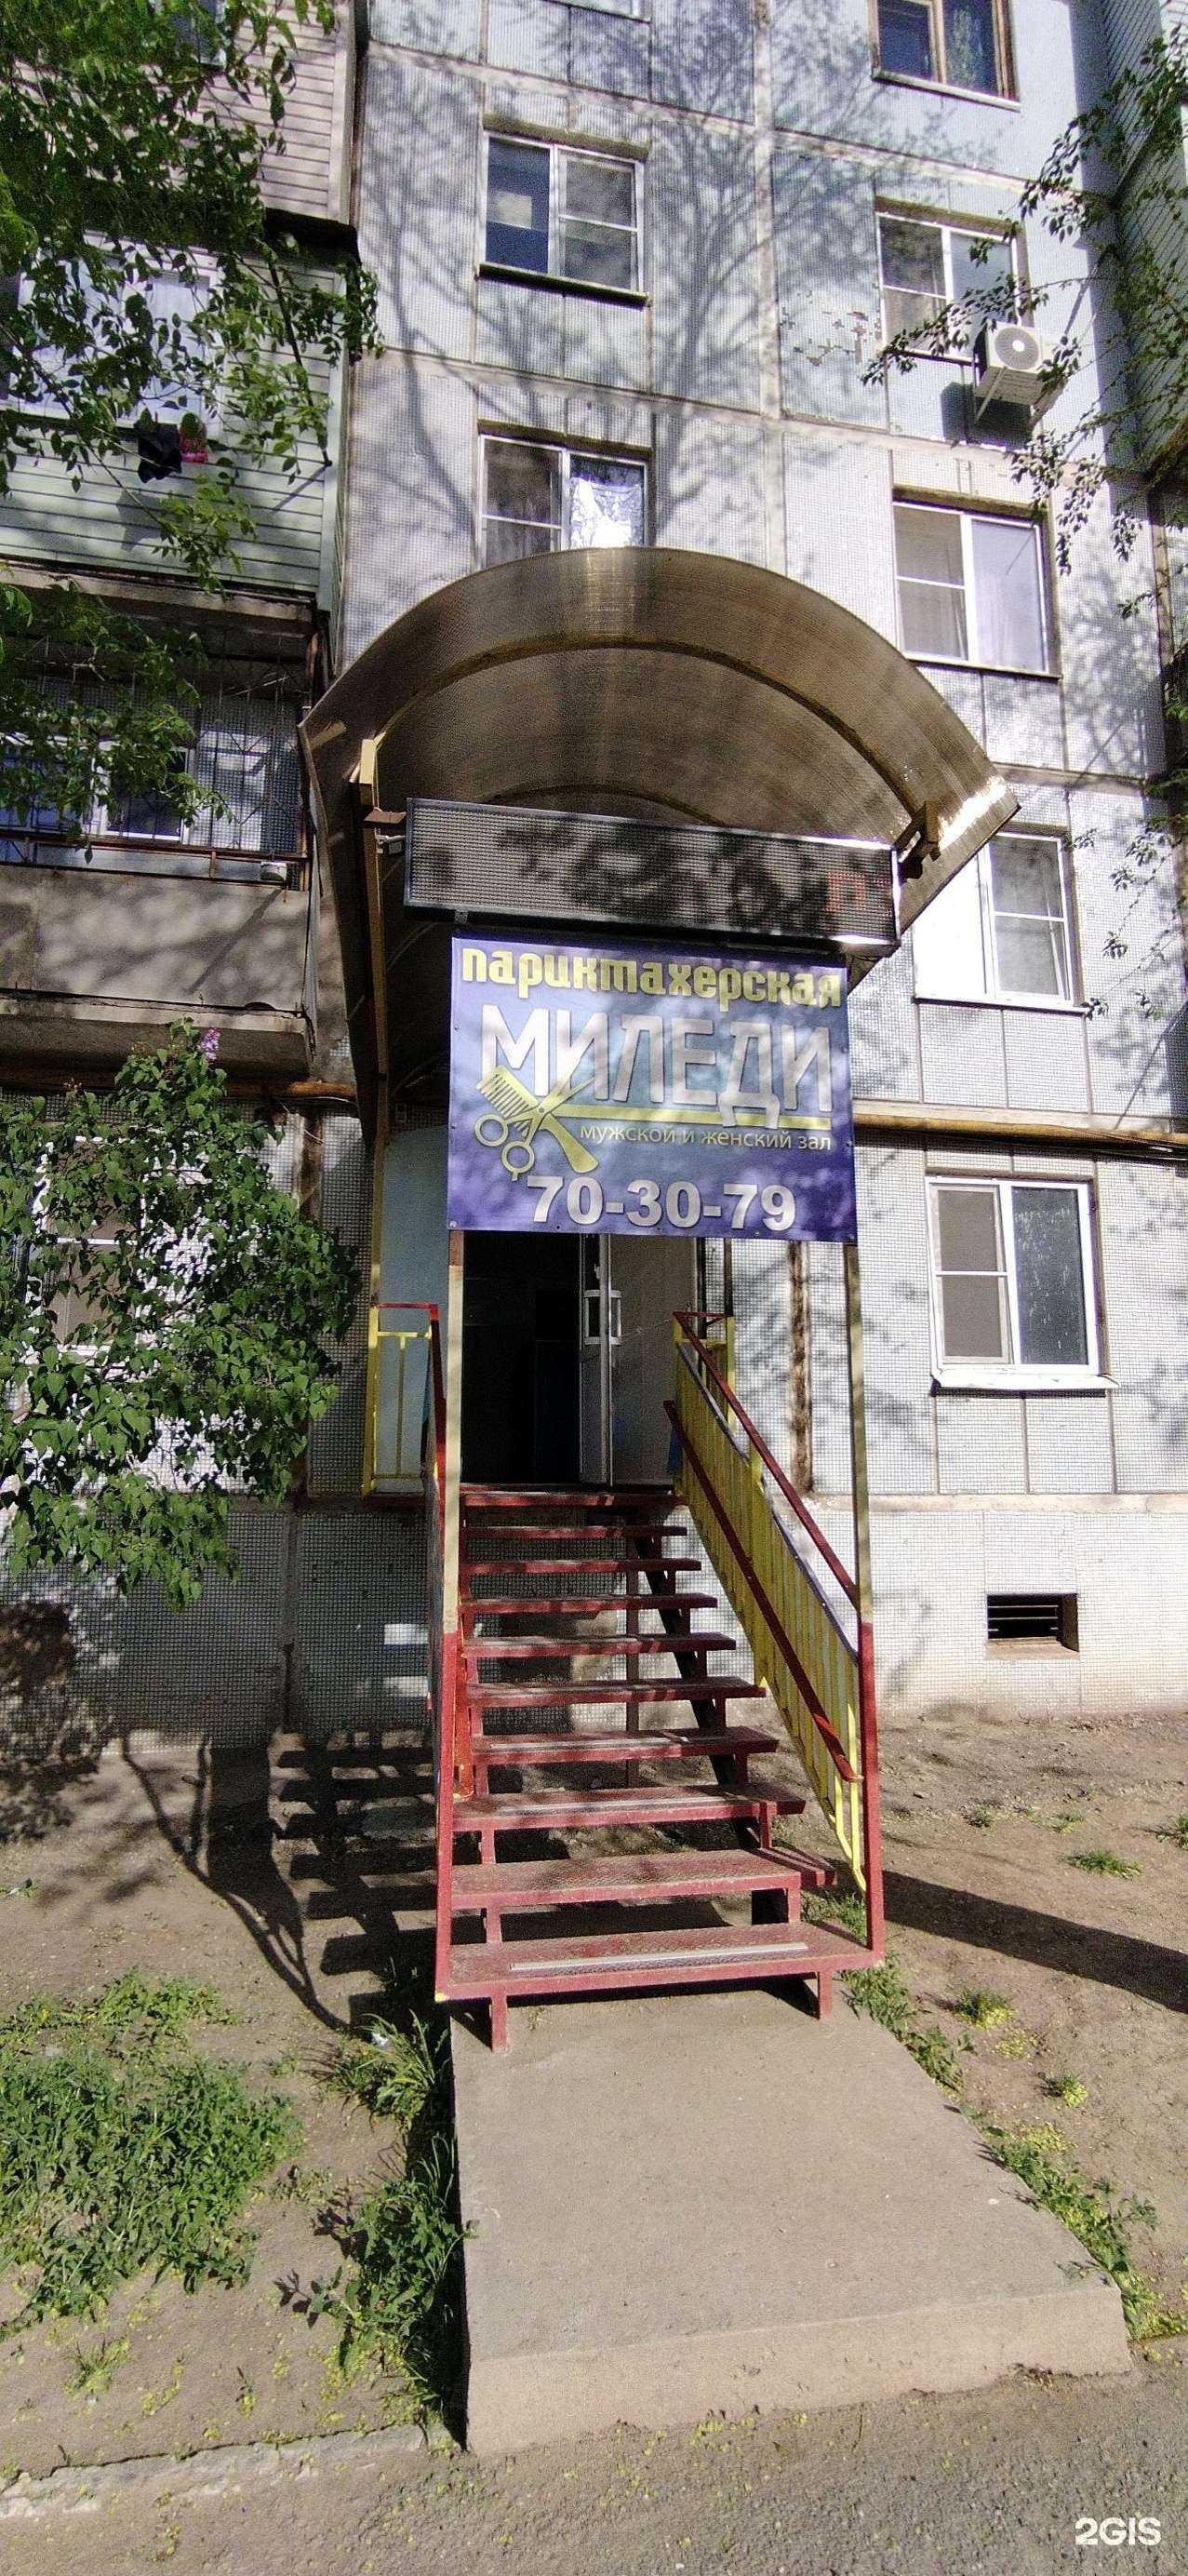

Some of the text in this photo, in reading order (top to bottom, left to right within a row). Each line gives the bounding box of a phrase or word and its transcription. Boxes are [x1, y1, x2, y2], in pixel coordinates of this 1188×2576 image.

[480, 1004, 833, 1129] МИЛЕДИ
[579, 1124, 832, 1151] мужской и женский зал
[527, 1175, 796, 1232] 70-30-79
